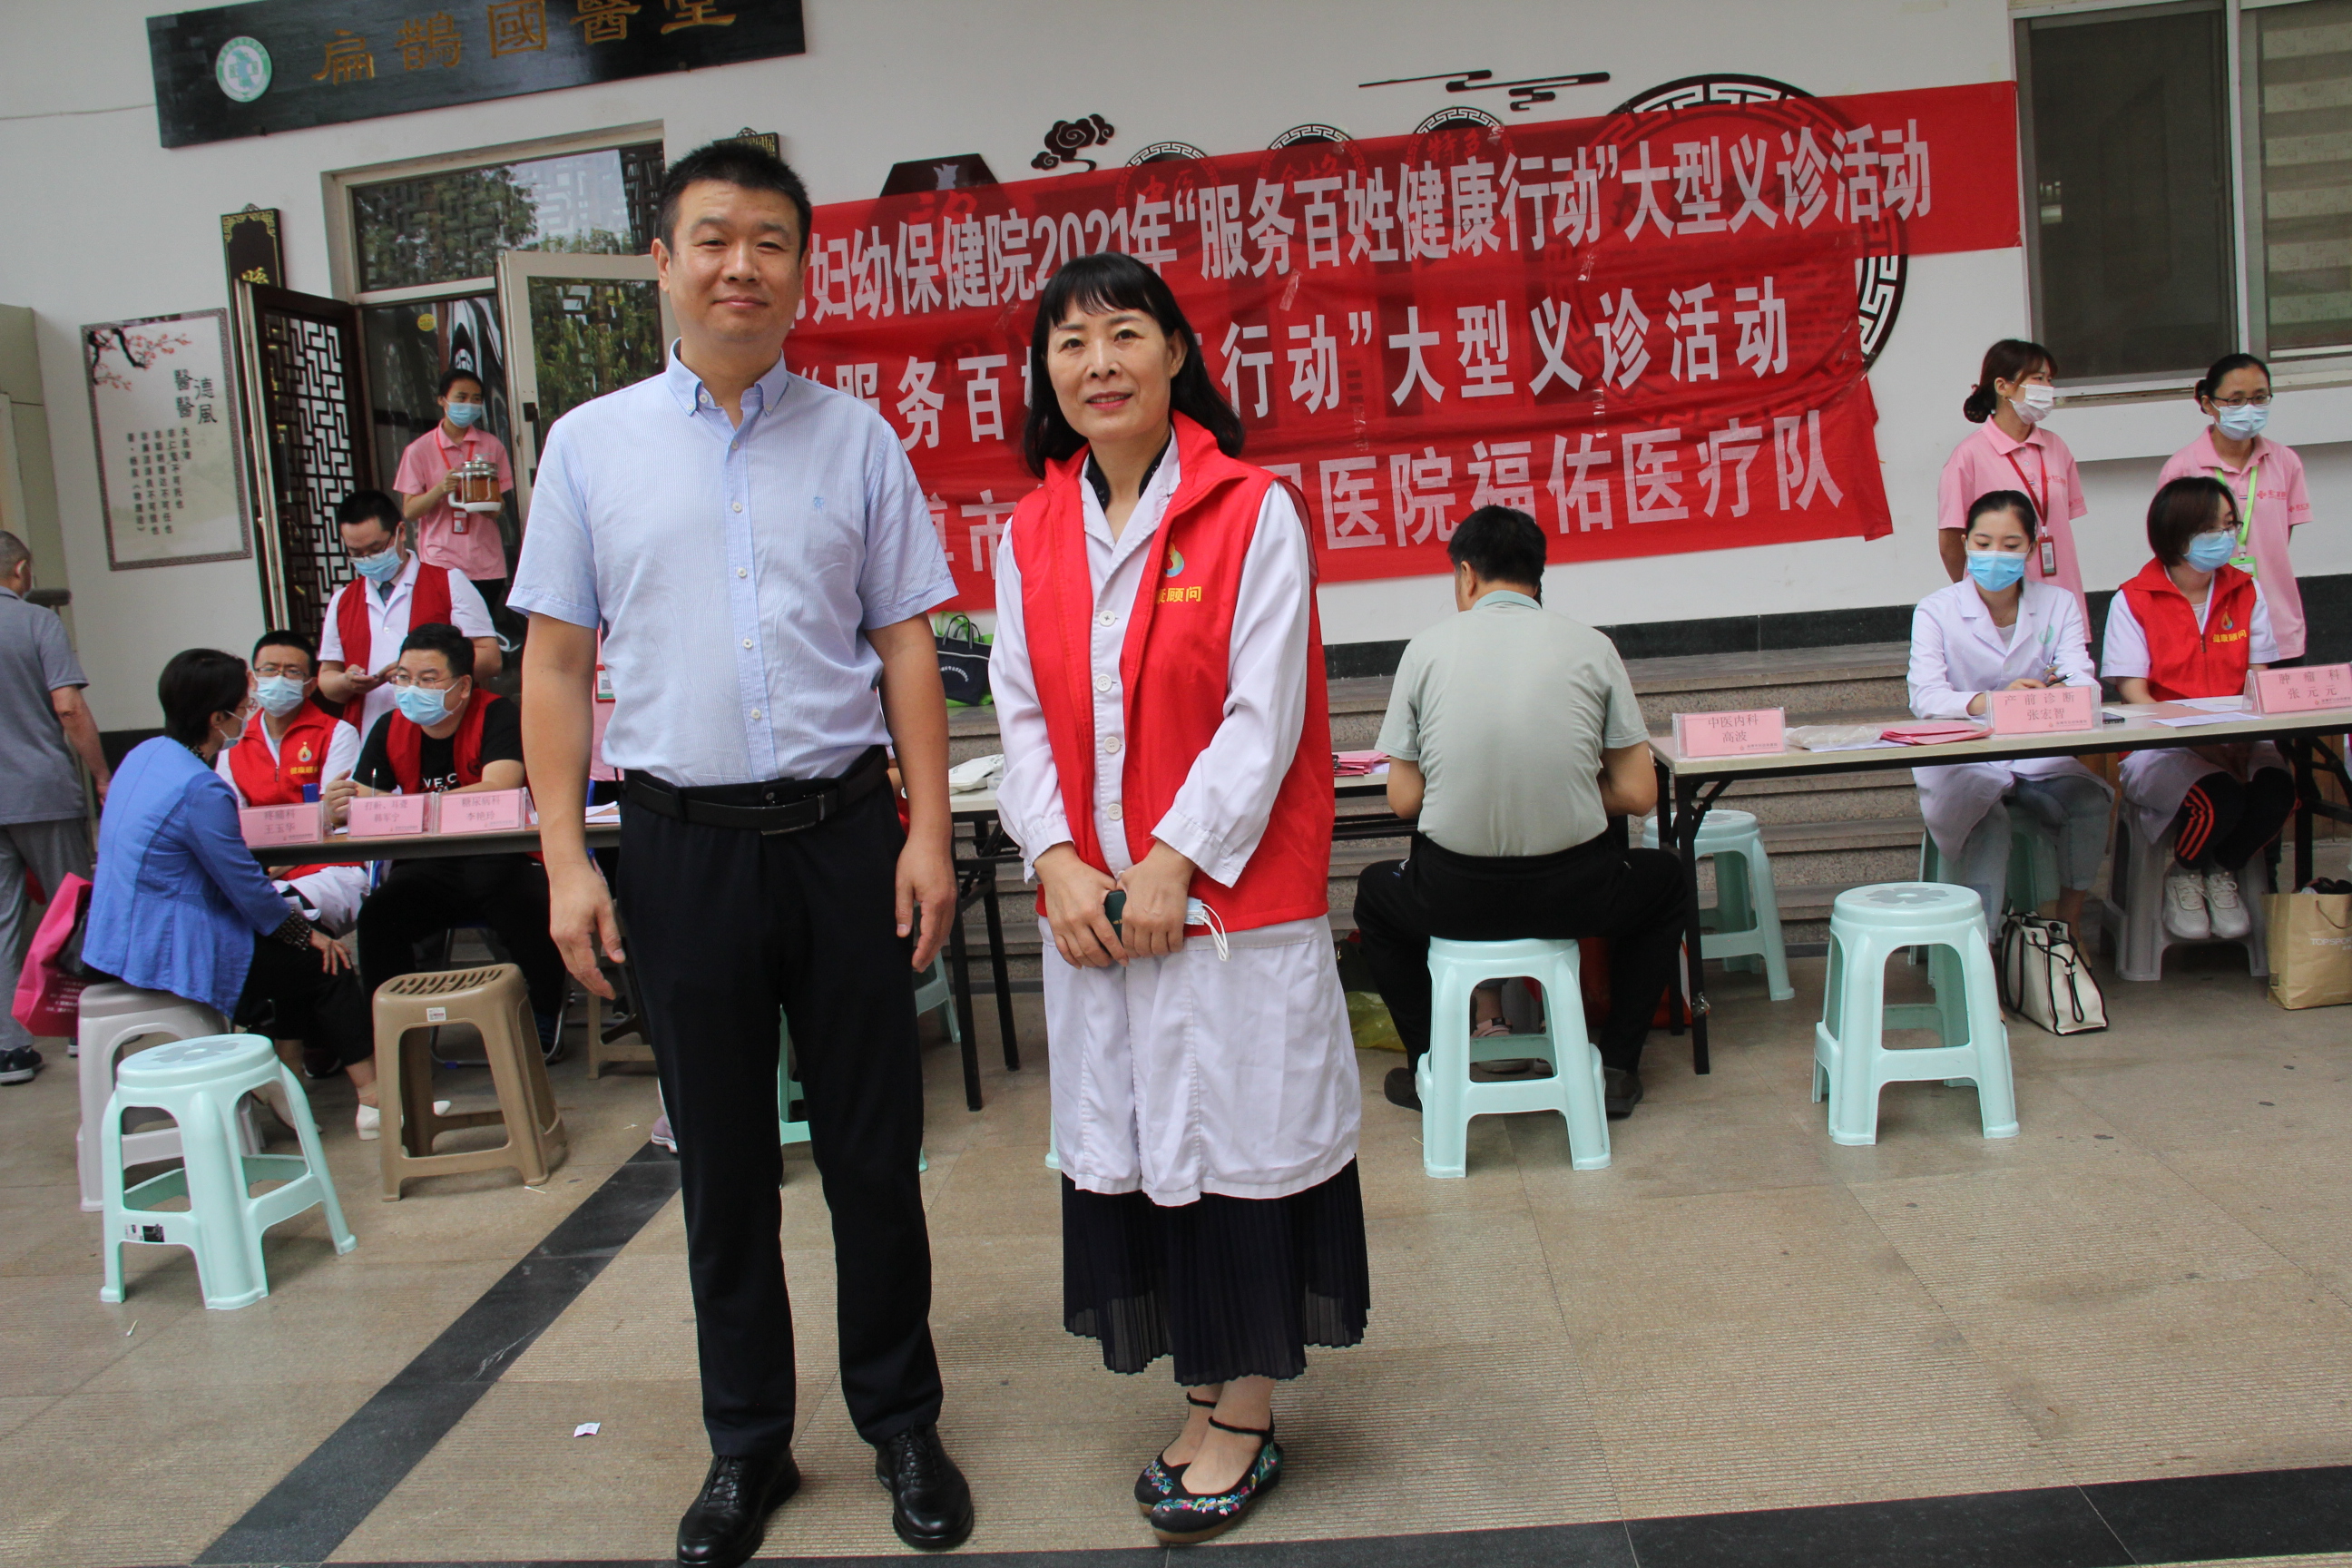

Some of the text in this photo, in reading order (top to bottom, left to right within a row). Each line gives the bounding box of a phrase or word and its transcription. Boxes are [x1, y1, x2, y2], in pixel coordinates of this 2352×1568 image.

[785, 119, 1930, 328] 妇幼保健院2021年“服务百姓健康行动”大型义诊活动
[801, 276, 1788, 451] “服务百行动”大型义诊活动
[2212, 629, 2247, 642] 健康顾问
[2278, 669, 2340, 684] 肿瘤科
[2004, 691, 2075, 706] 产前诊断
[2288, 684, 2337, 699] 张元元
[1708, 713, 1759, 729] 中医内科
[2026, 707, 2064, 720] 张宏智
[1721, 730, 1748, 743] 高波
[461, 795, 500, 807] 糖尿病科
